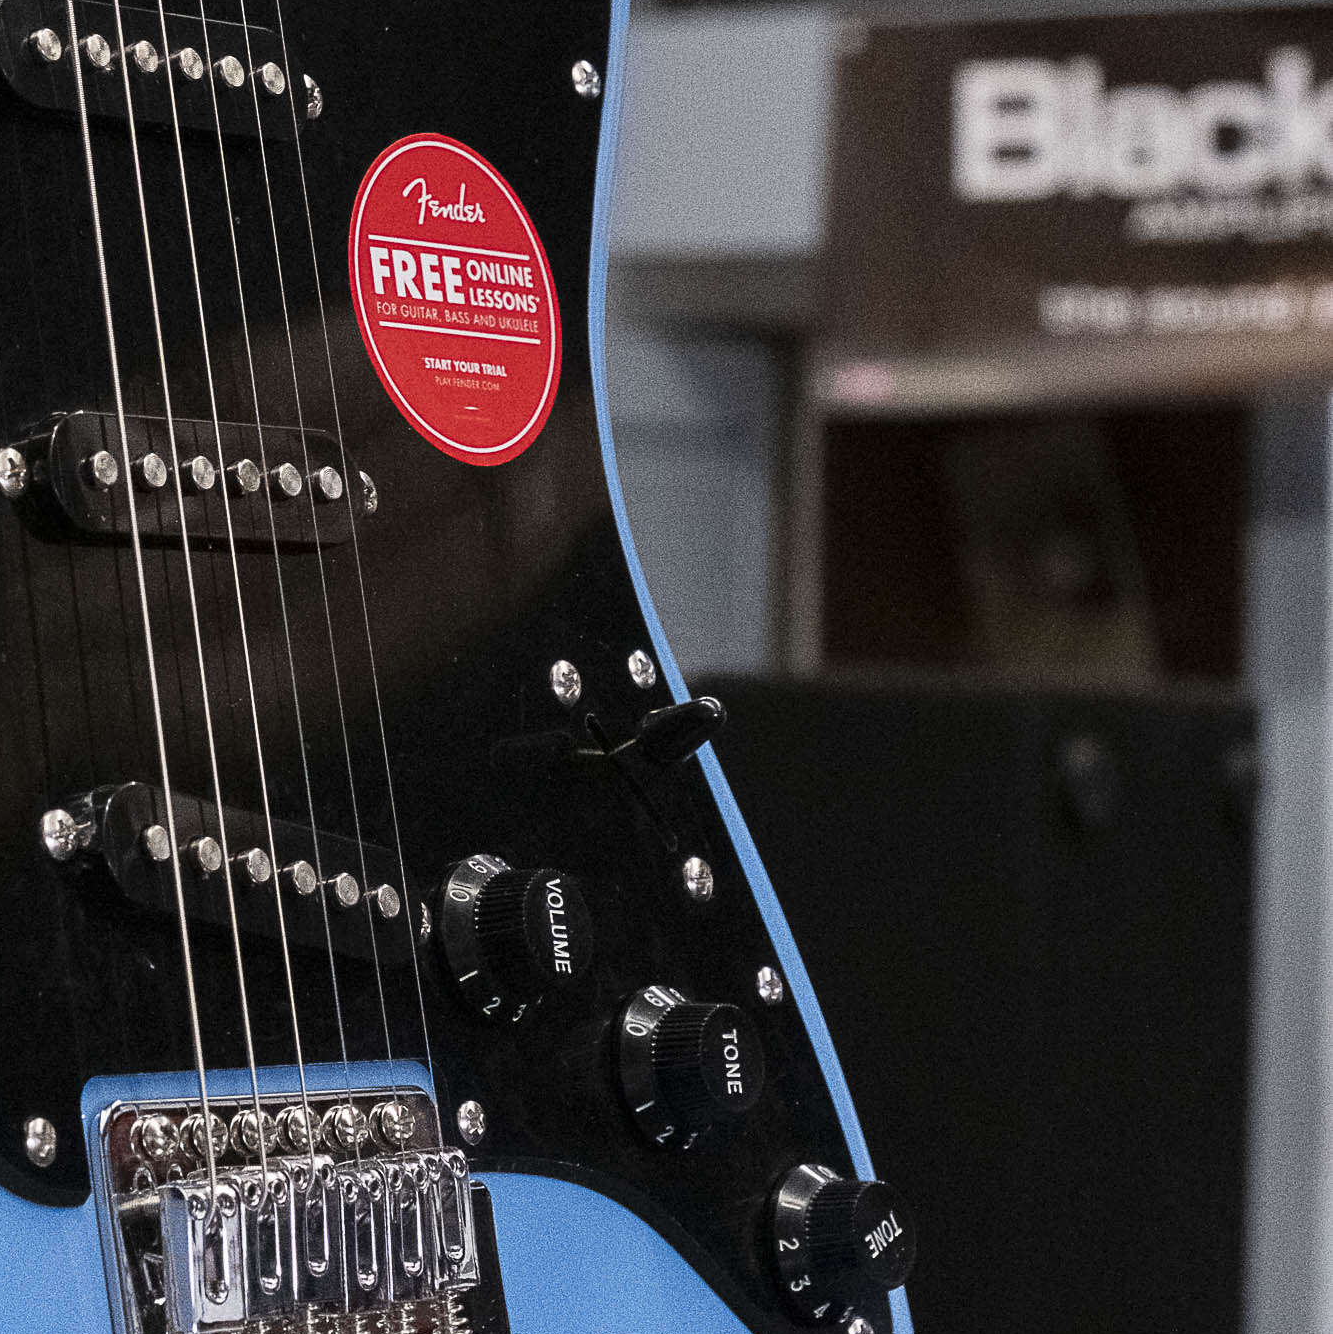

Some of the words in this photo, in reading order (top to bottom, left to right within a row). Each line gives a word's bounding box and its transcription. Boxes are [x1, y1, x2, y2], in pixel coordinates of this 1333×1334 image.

[402, 177, 486, 225] Fender
[369, 246, 466, 305] FREE
[465, 259, 535, 289] ONLINE
[376, 301, 397, 316] FOR
[444, 309, 470, 325] BASS
[473, 314, 496, 328] AND
[498, 316, 539, 334] UKULELE
[424, 357, 452, 372] START
[453, 360, 481, 375] YOUR
[481, 363, 508, 378] TRIAL
[545, 878, 572, 974] VOLUME
[482, 996, 501, 1015] 2
[721, 1028, 743, 1095] TONE
[656, 1125, 675, 1144] 2
[864, 1210, 903, 1259] TONE
[778, 1237, 800, 1252] 2
[790, 1274, 812, 1292] 3
[813, 1302, 831, 1319] 4
